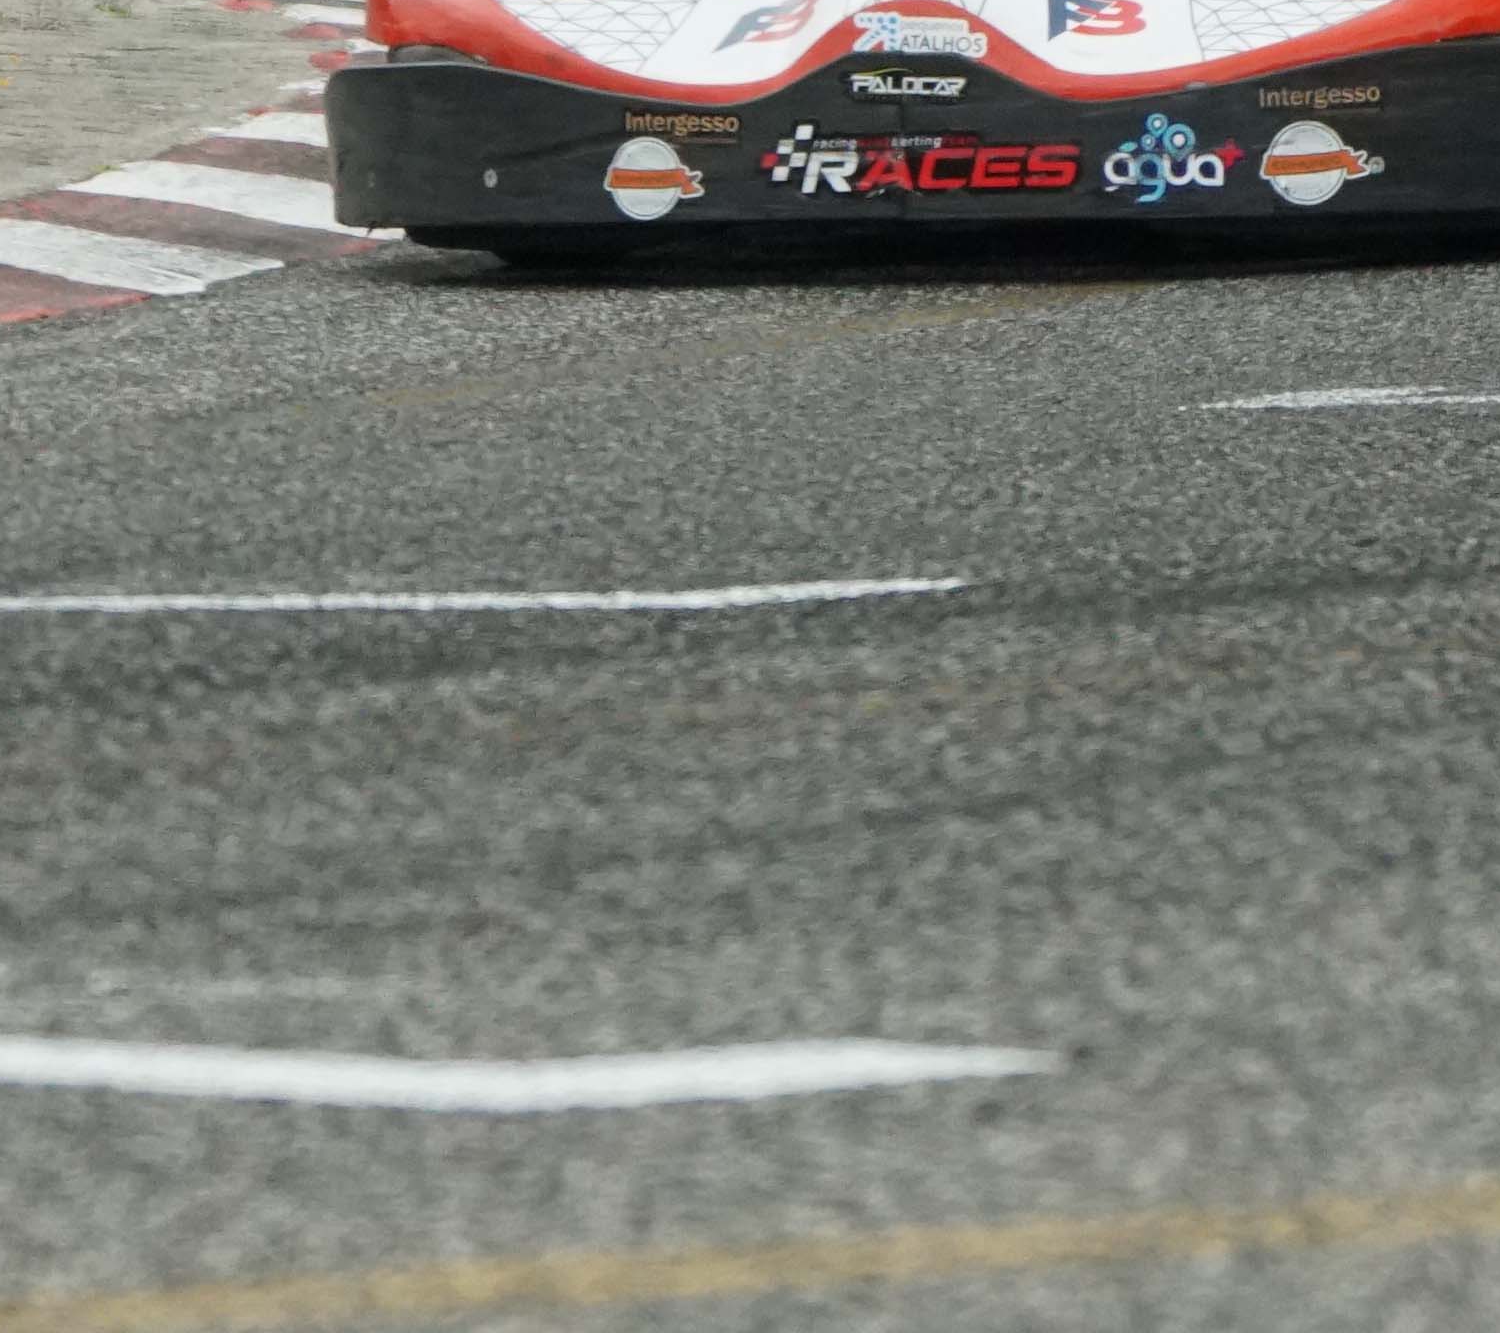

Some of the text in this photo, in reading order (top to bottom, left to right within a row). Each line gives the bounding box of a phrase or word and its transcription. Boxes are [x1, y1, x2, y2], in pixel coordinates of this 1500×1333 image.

[902, 34, 985, 53] ATALHOS
[1259, 85, 1381, 107] Intergesso
[625, 111, 740, 136] Intergesso
[801, 145, 1081, 196] RACES
